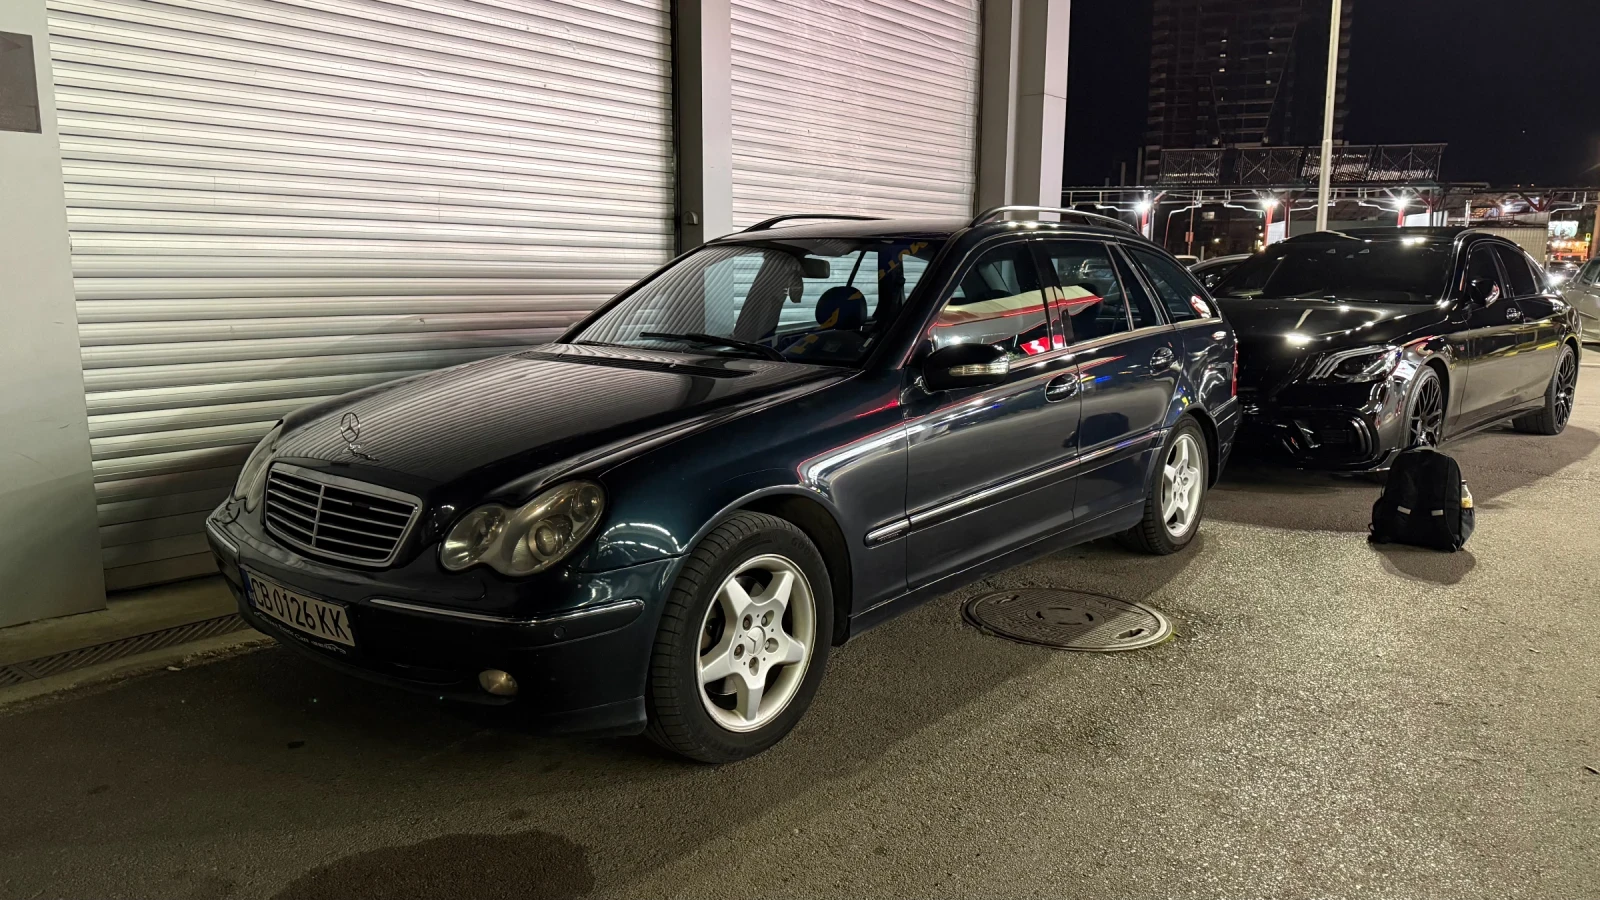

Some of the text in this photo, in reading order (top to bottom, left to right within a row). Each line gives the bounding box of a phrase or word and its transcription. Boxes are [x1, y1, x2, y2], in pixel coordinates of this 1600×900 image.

[251, 578, 273, 611] CB
[273, 589, 316, 630] 0126
[315, 604, 349, 640] KK
